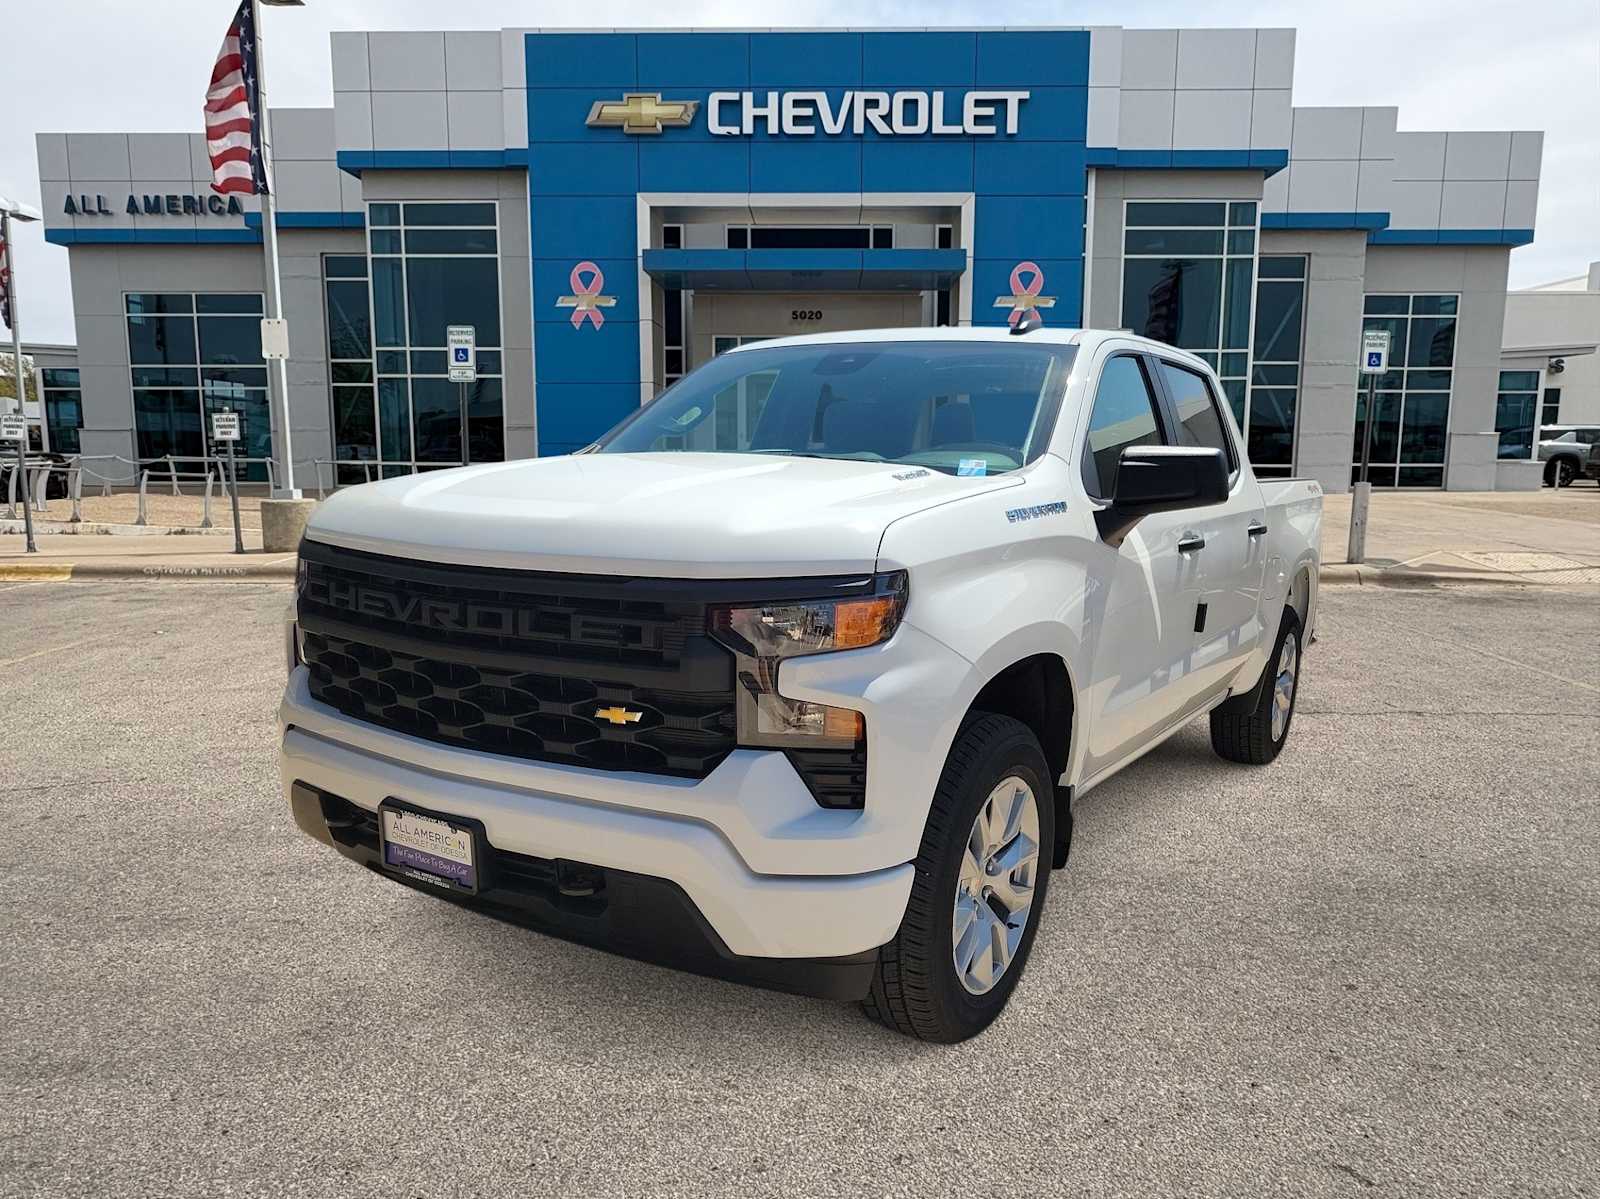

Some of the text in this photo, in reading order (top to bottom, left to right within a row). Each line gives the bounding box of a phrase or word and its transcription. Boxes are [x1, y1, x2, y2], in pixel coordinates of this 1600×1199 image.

[707, 90, 1031, 136] CHEVROLET
[64, 194, 245, 216] ALL AMERICA
[791, 310, 823, 320] 5020
[306, 576, 682, 652] CHEVROLET
[393, 822, 466, 851] ALL AMERICN
